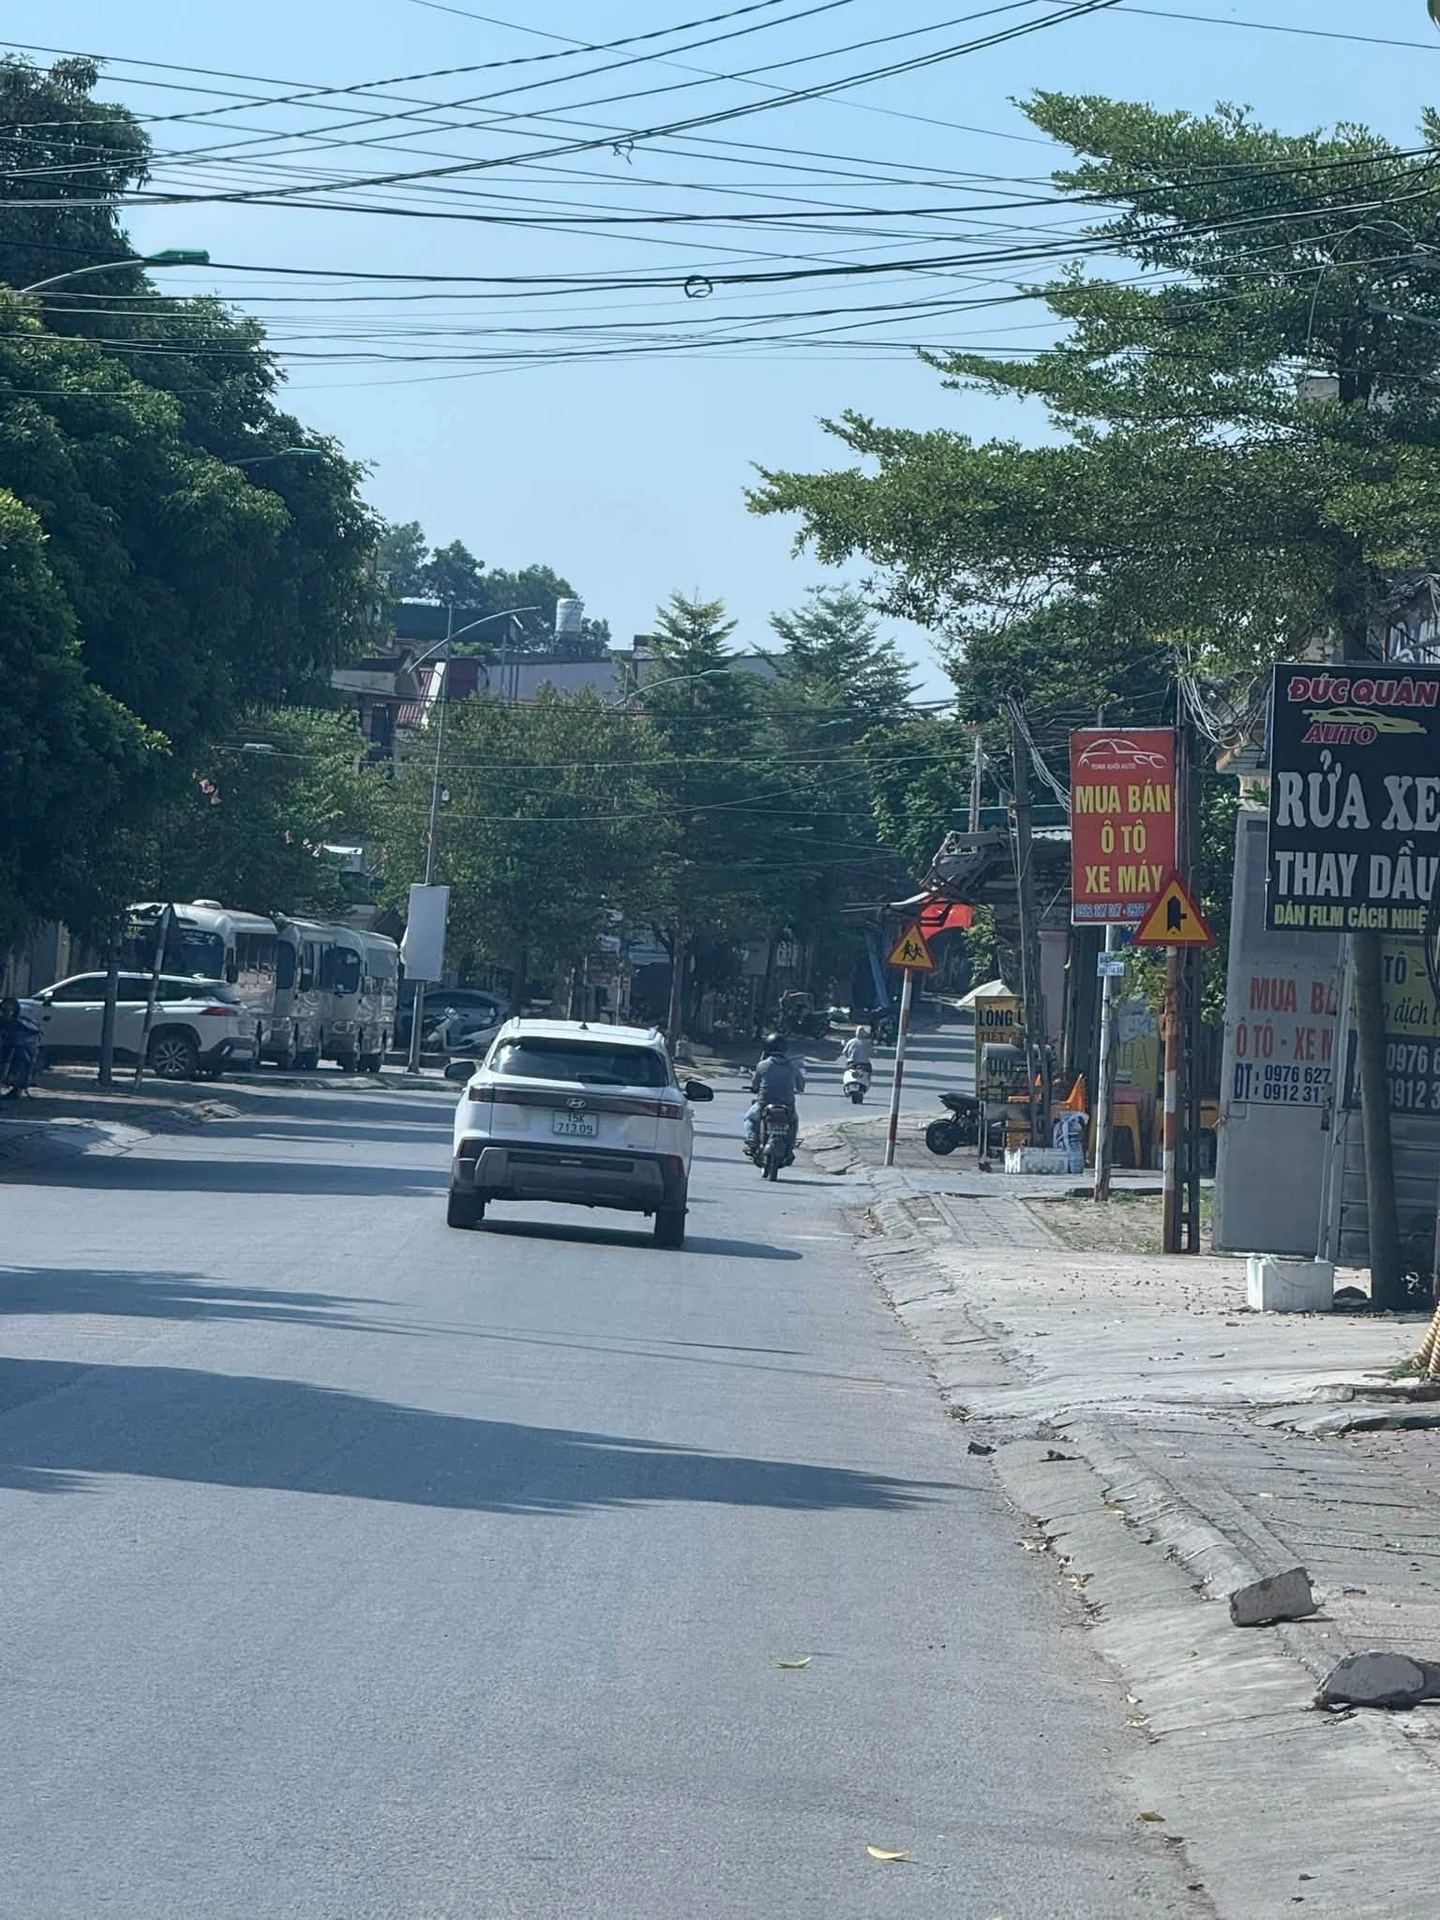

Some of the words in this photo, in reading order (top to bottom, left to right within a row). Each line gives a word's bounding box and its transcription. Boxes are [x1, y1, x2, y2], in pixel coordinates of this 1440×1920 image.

[1289, 673, 1350, 702] ĐỨC
[1351, 676, 1439, 707] QUÂN
[1302, 723, 1377, 745] AUTO
[1076, 785, 1122, 814] MUA
[1128, 779, 1170, 814] BÁN
[1276, 749, 1371, 830] RỬA
[1381, 775, 1440, 832] XE
[1101, 820, 1114, 854] Ô
[1121, 819, 1146, 854] TÔ
[1085, 865, 1110, 894] XE
[1118, 859, 1163, 894] MÁY
[1275, 851, 1358, 898] THAY
[1369, 840, 1439, 901] DẦU
[1274, 900, 1306, 925] DÁN
[1308, 905, 1345, 927] FILM
[1348, 903, 1387, 928] CÁCH
[1392, 905, 1428, 934] NHIỆ
[1383, 952, 1407, 984] TÔ
[1250, 977, 1297, 1013] MUA
[1236, 1016, 1247, 1058] Ô
[1253, 1017, 1274, 1059] TÔ
[1293, 1027, 1316, 1061] XE
[1265, 1064, 1300, 1083] 0976
[1304, 1066, 1331, 1084] 627
[1263, 1083, 1299, 1102] 0912
[1303, 1085, 1323, 1103] 31
